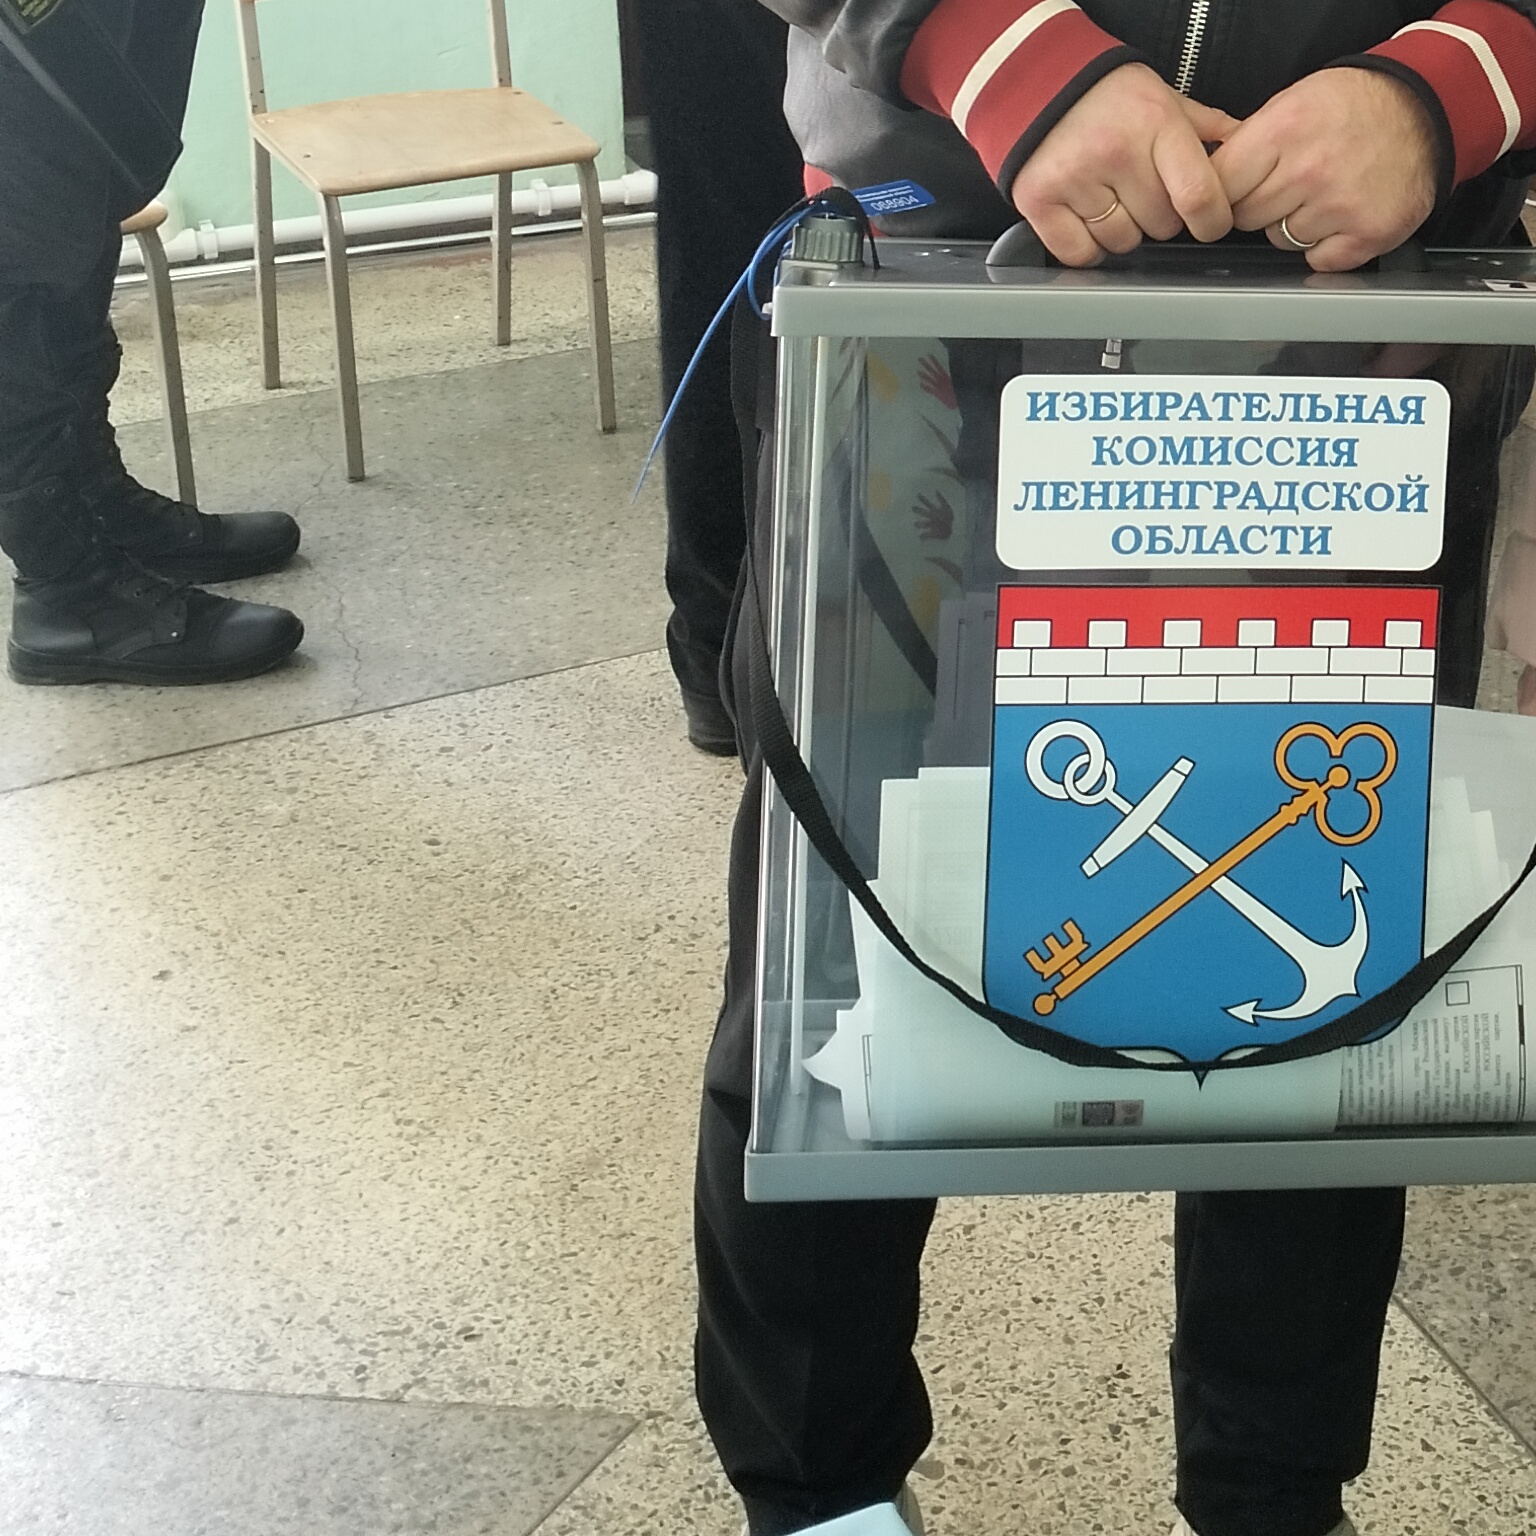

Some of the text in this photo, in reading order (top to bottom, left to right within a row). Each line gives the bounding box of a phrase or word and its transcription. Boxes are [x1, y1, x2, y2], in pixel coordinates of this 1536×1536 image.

[1025, 390, 1427, 426] ИЗБИРАТЕЛЬНАЯ
[1091, 435, 1360, 468] КОМИССИЯ
[1013, 474, 1430, 516] ЛЕНИНГРАДСКОЙ
[1111, 524, 1333, 556] ОБЛАСТИ
